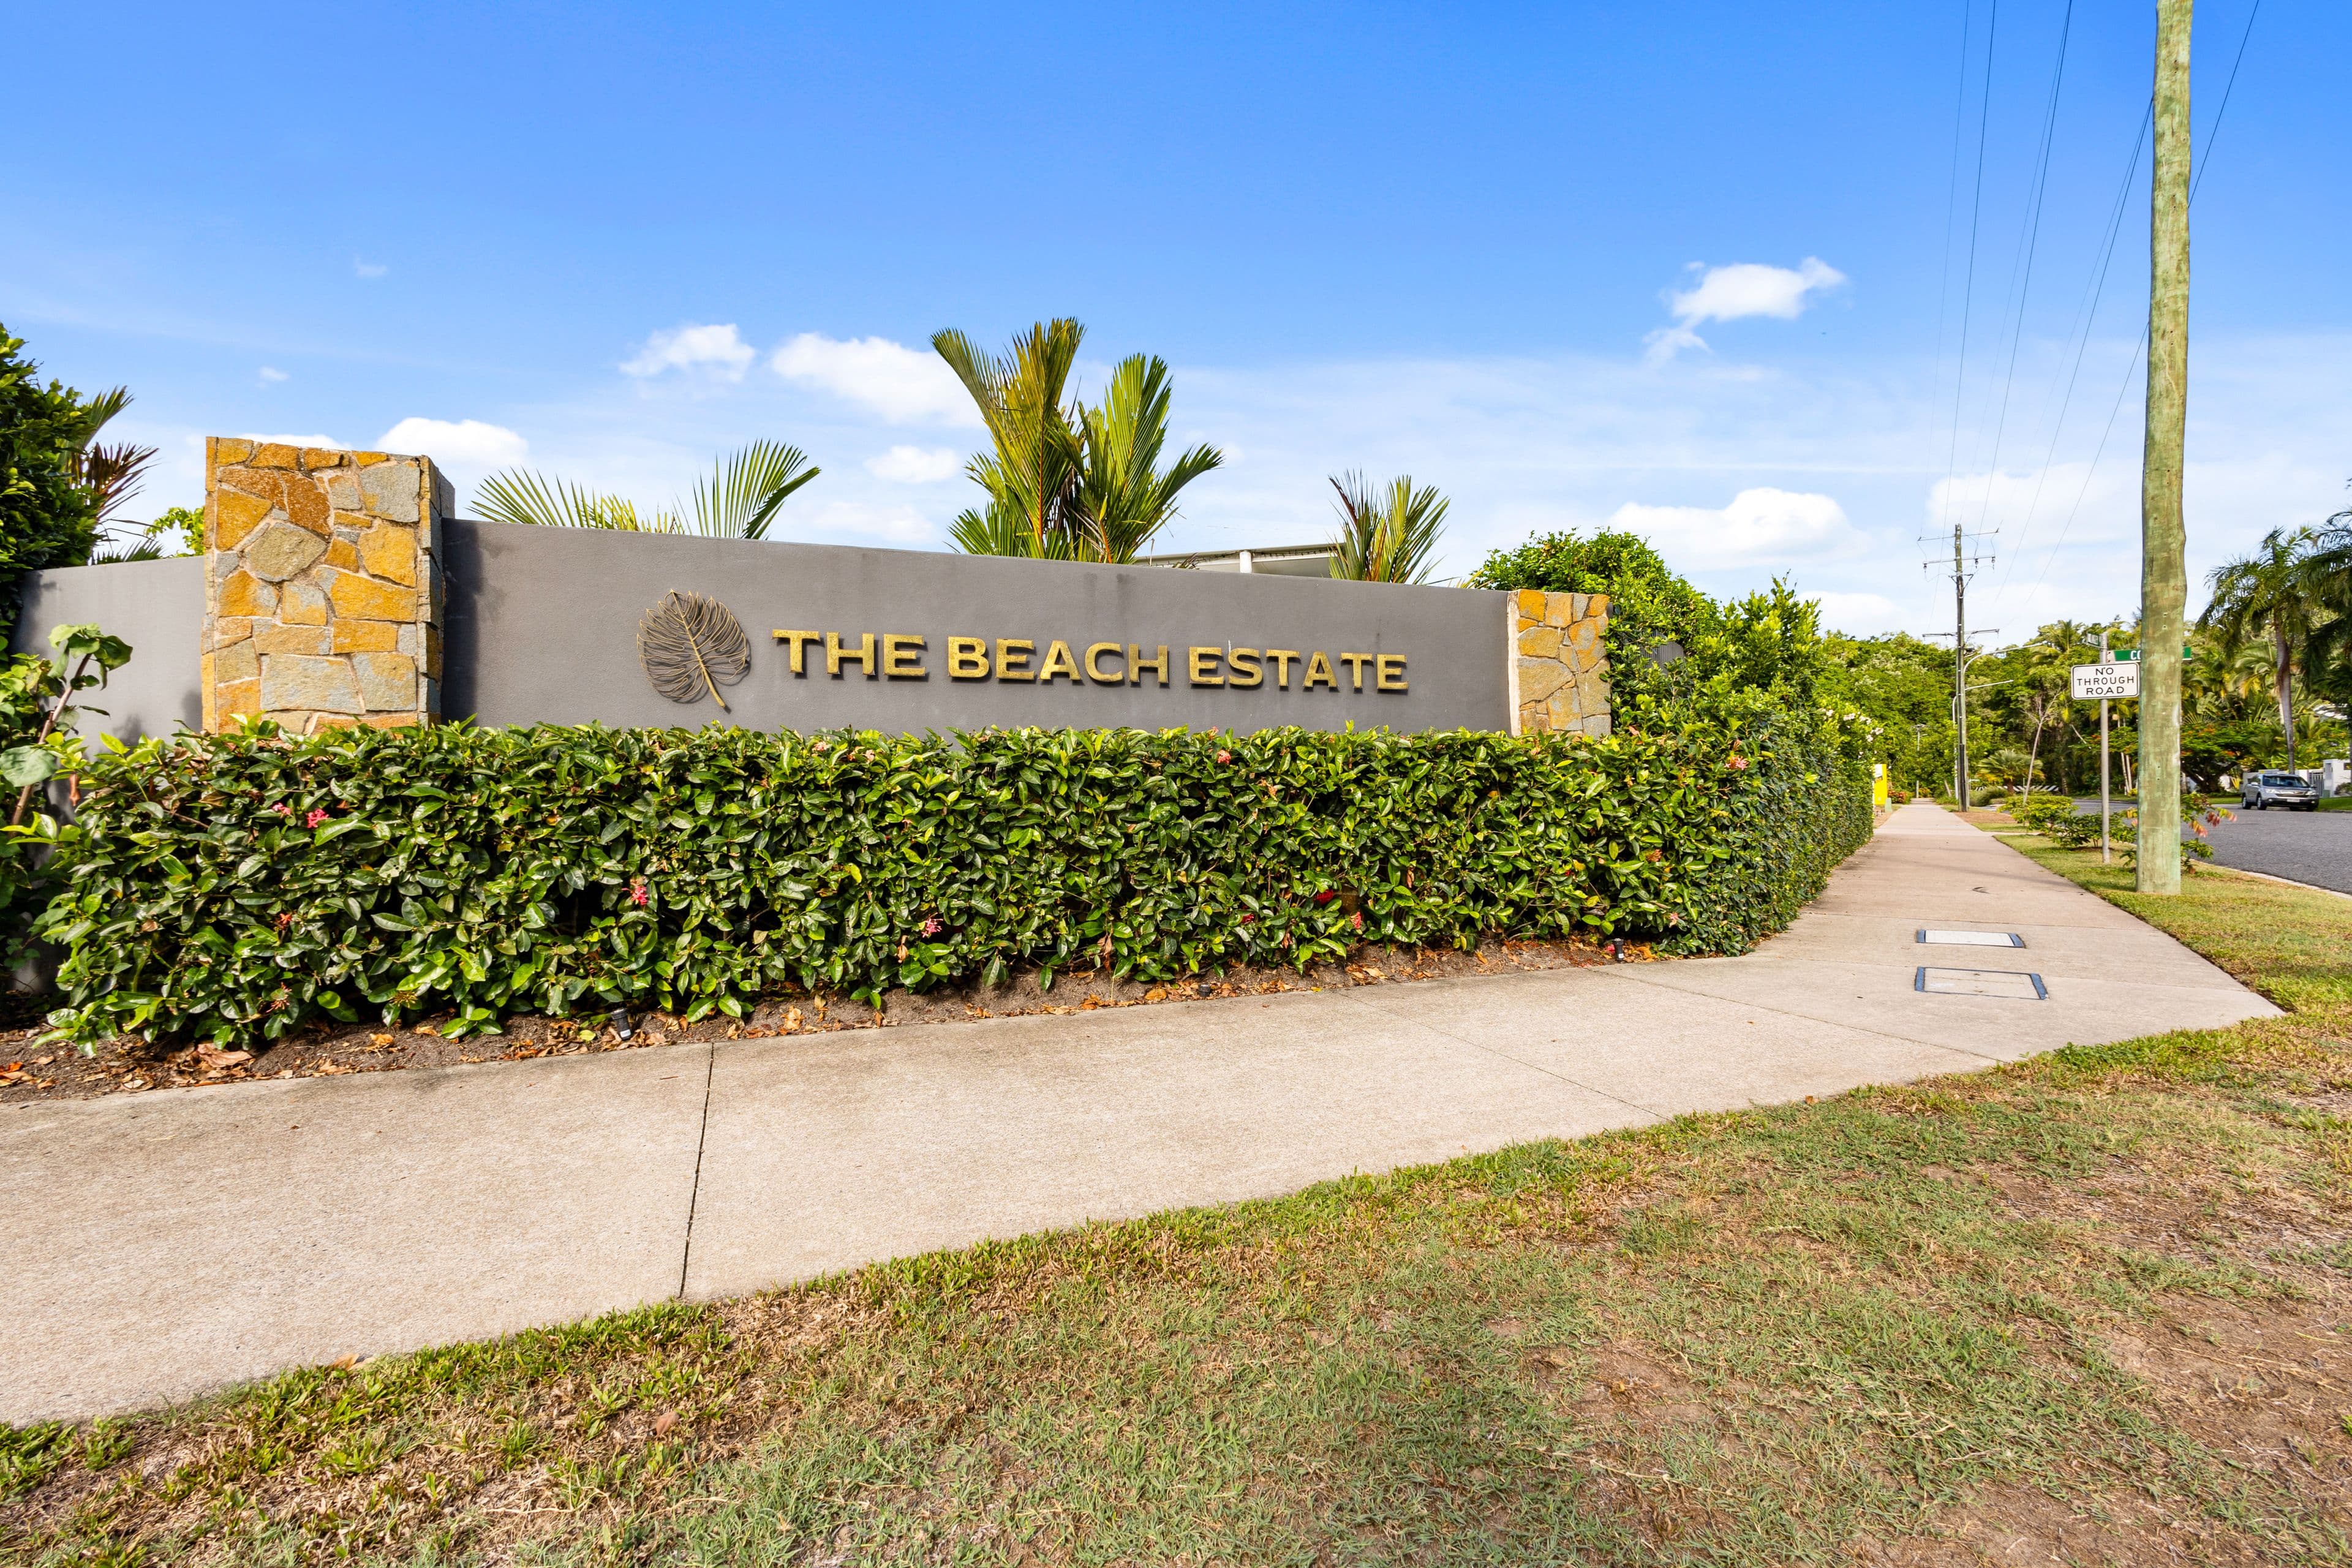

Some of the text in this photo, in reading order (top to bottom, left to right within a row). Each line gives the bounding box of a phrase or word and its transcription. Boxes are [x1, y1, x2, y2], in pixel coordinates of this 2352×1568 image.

[772, 628, 1409, 690] THE BEACH ESTATE
[2095, 667, 2114, 676] NO
[2076, 676, 2135, 686] THROUGH
[2086, 686, 2125, 695] ROAD
